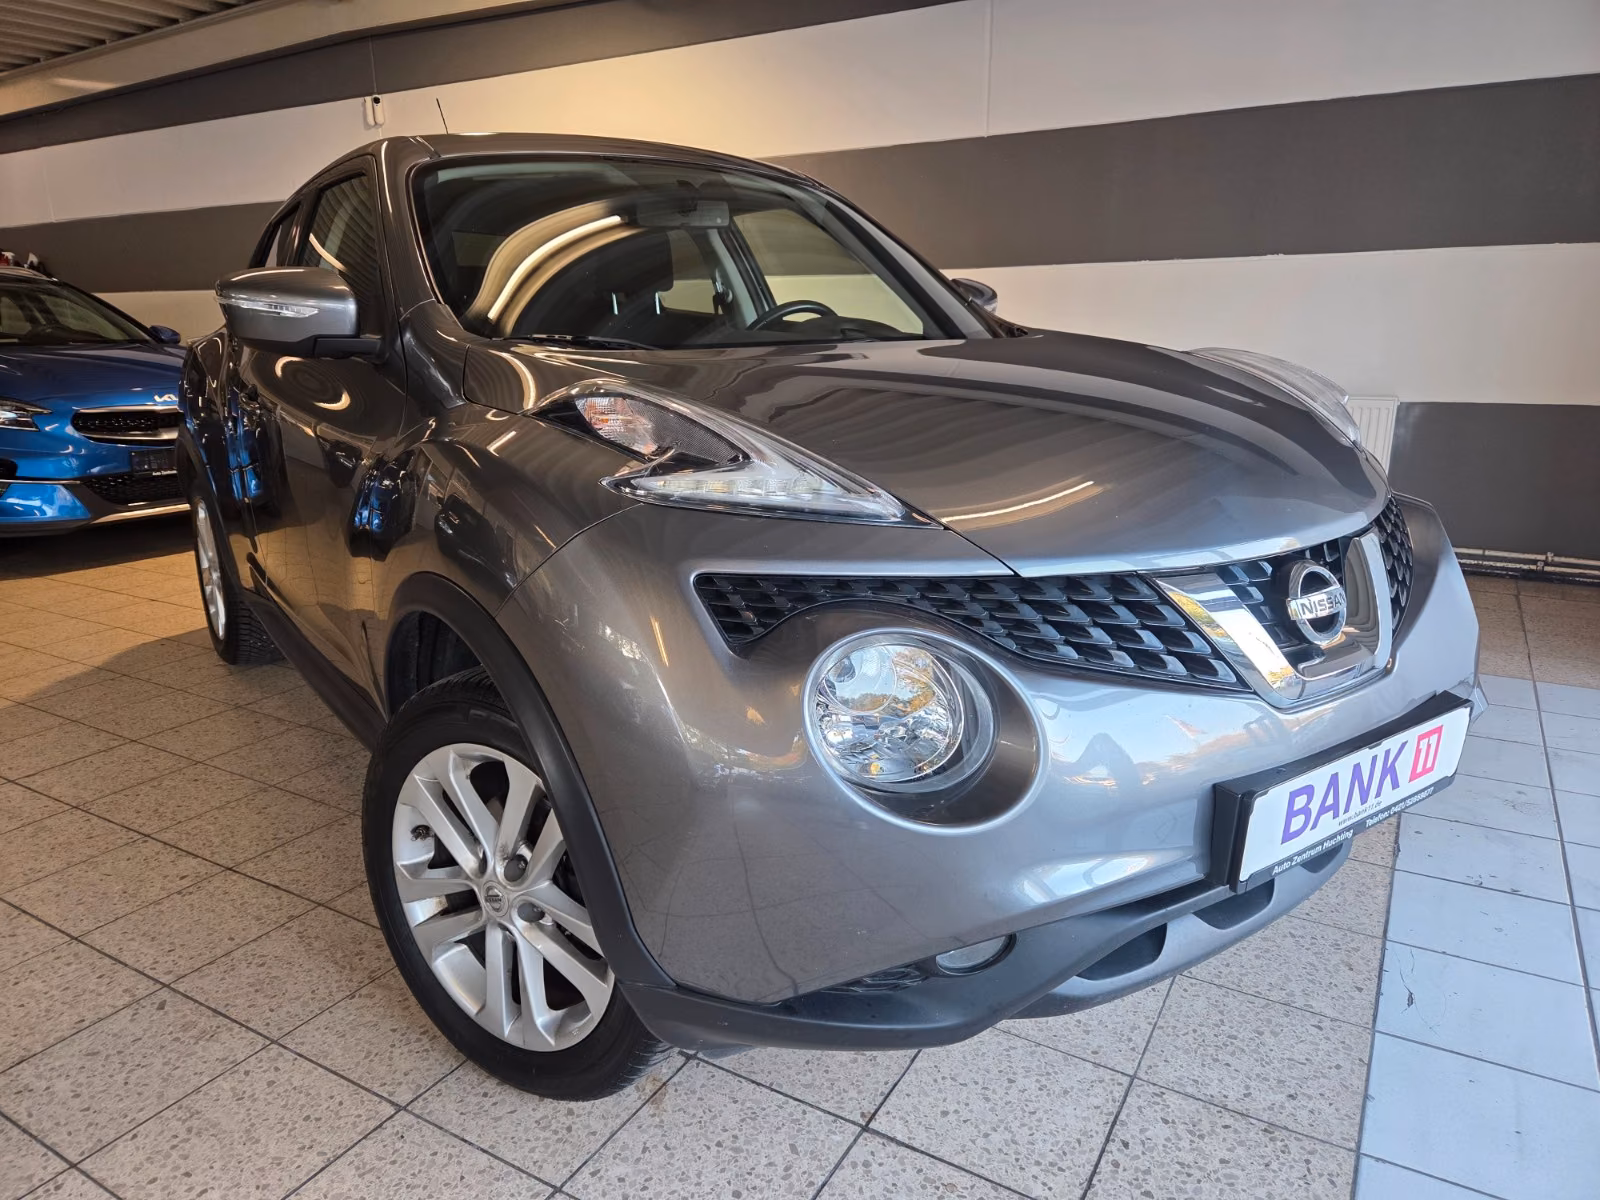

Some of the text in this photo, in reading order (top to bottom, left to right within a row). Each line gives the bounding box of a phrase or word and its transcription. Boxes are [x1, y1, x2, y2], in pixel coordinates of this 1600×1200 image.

[1301, 592, 1346, 616] NISSAN
[1281, 740, 1408, 845] BANK
[1365, 810, 1390, 828] Telefon:
[1272, 829, 1354, 876] Auto Zentrum Huchting
